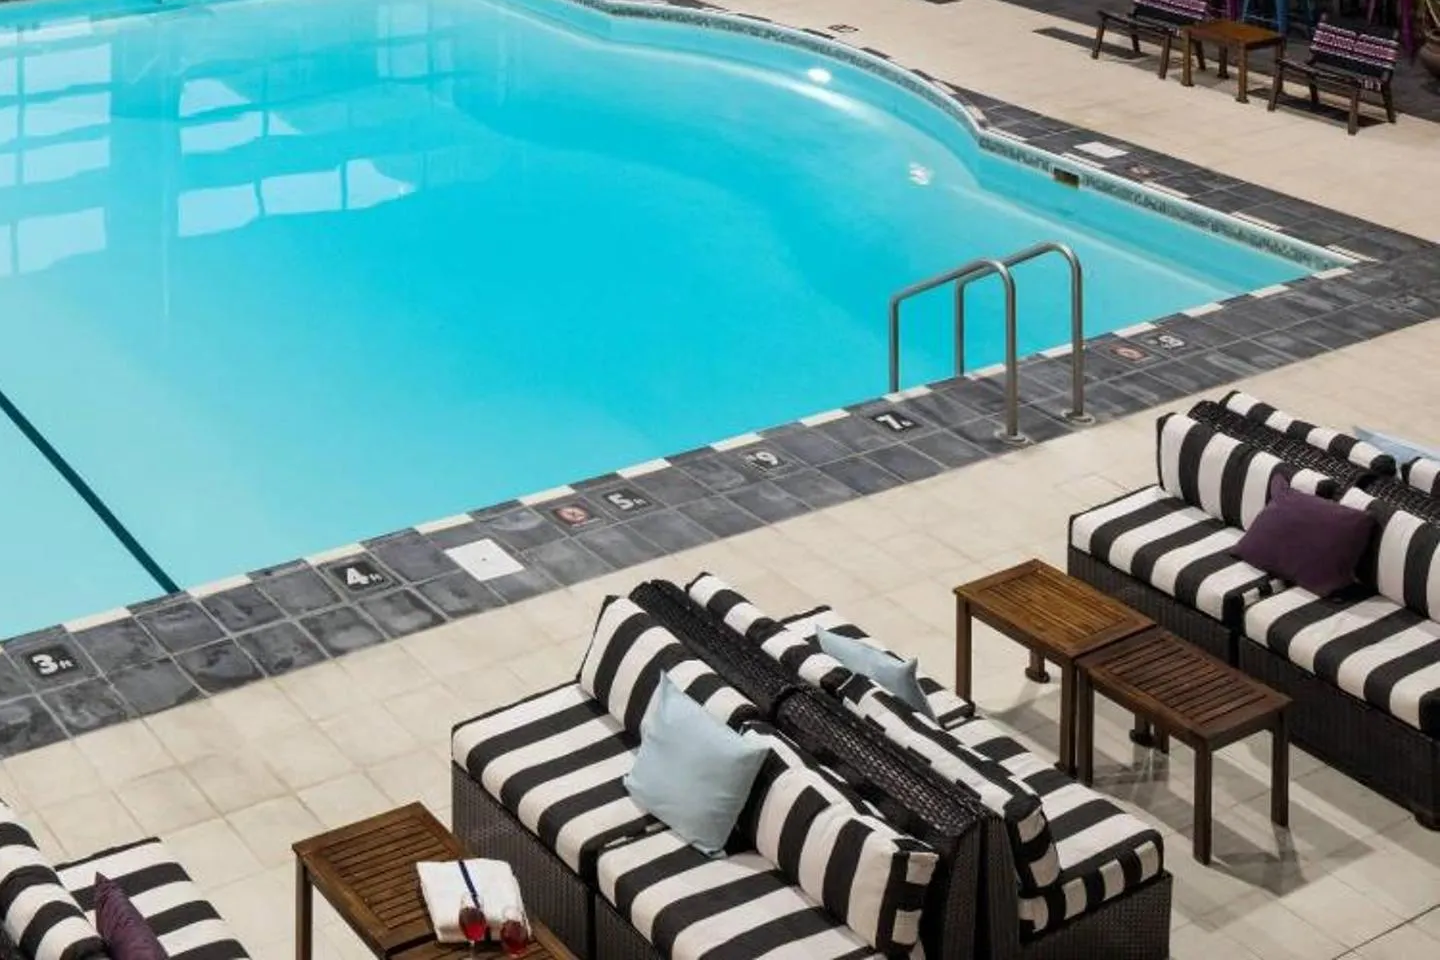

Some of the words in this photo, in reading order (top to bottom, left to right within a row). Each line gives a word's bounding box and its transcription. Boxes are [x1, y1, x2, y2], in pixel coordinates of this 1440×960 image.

[876, 413, 904, 430] 7
[607, 492, 635, 511] 5
[346, 567, 370, 585] 4
[32, 654, 58, 674] 3
